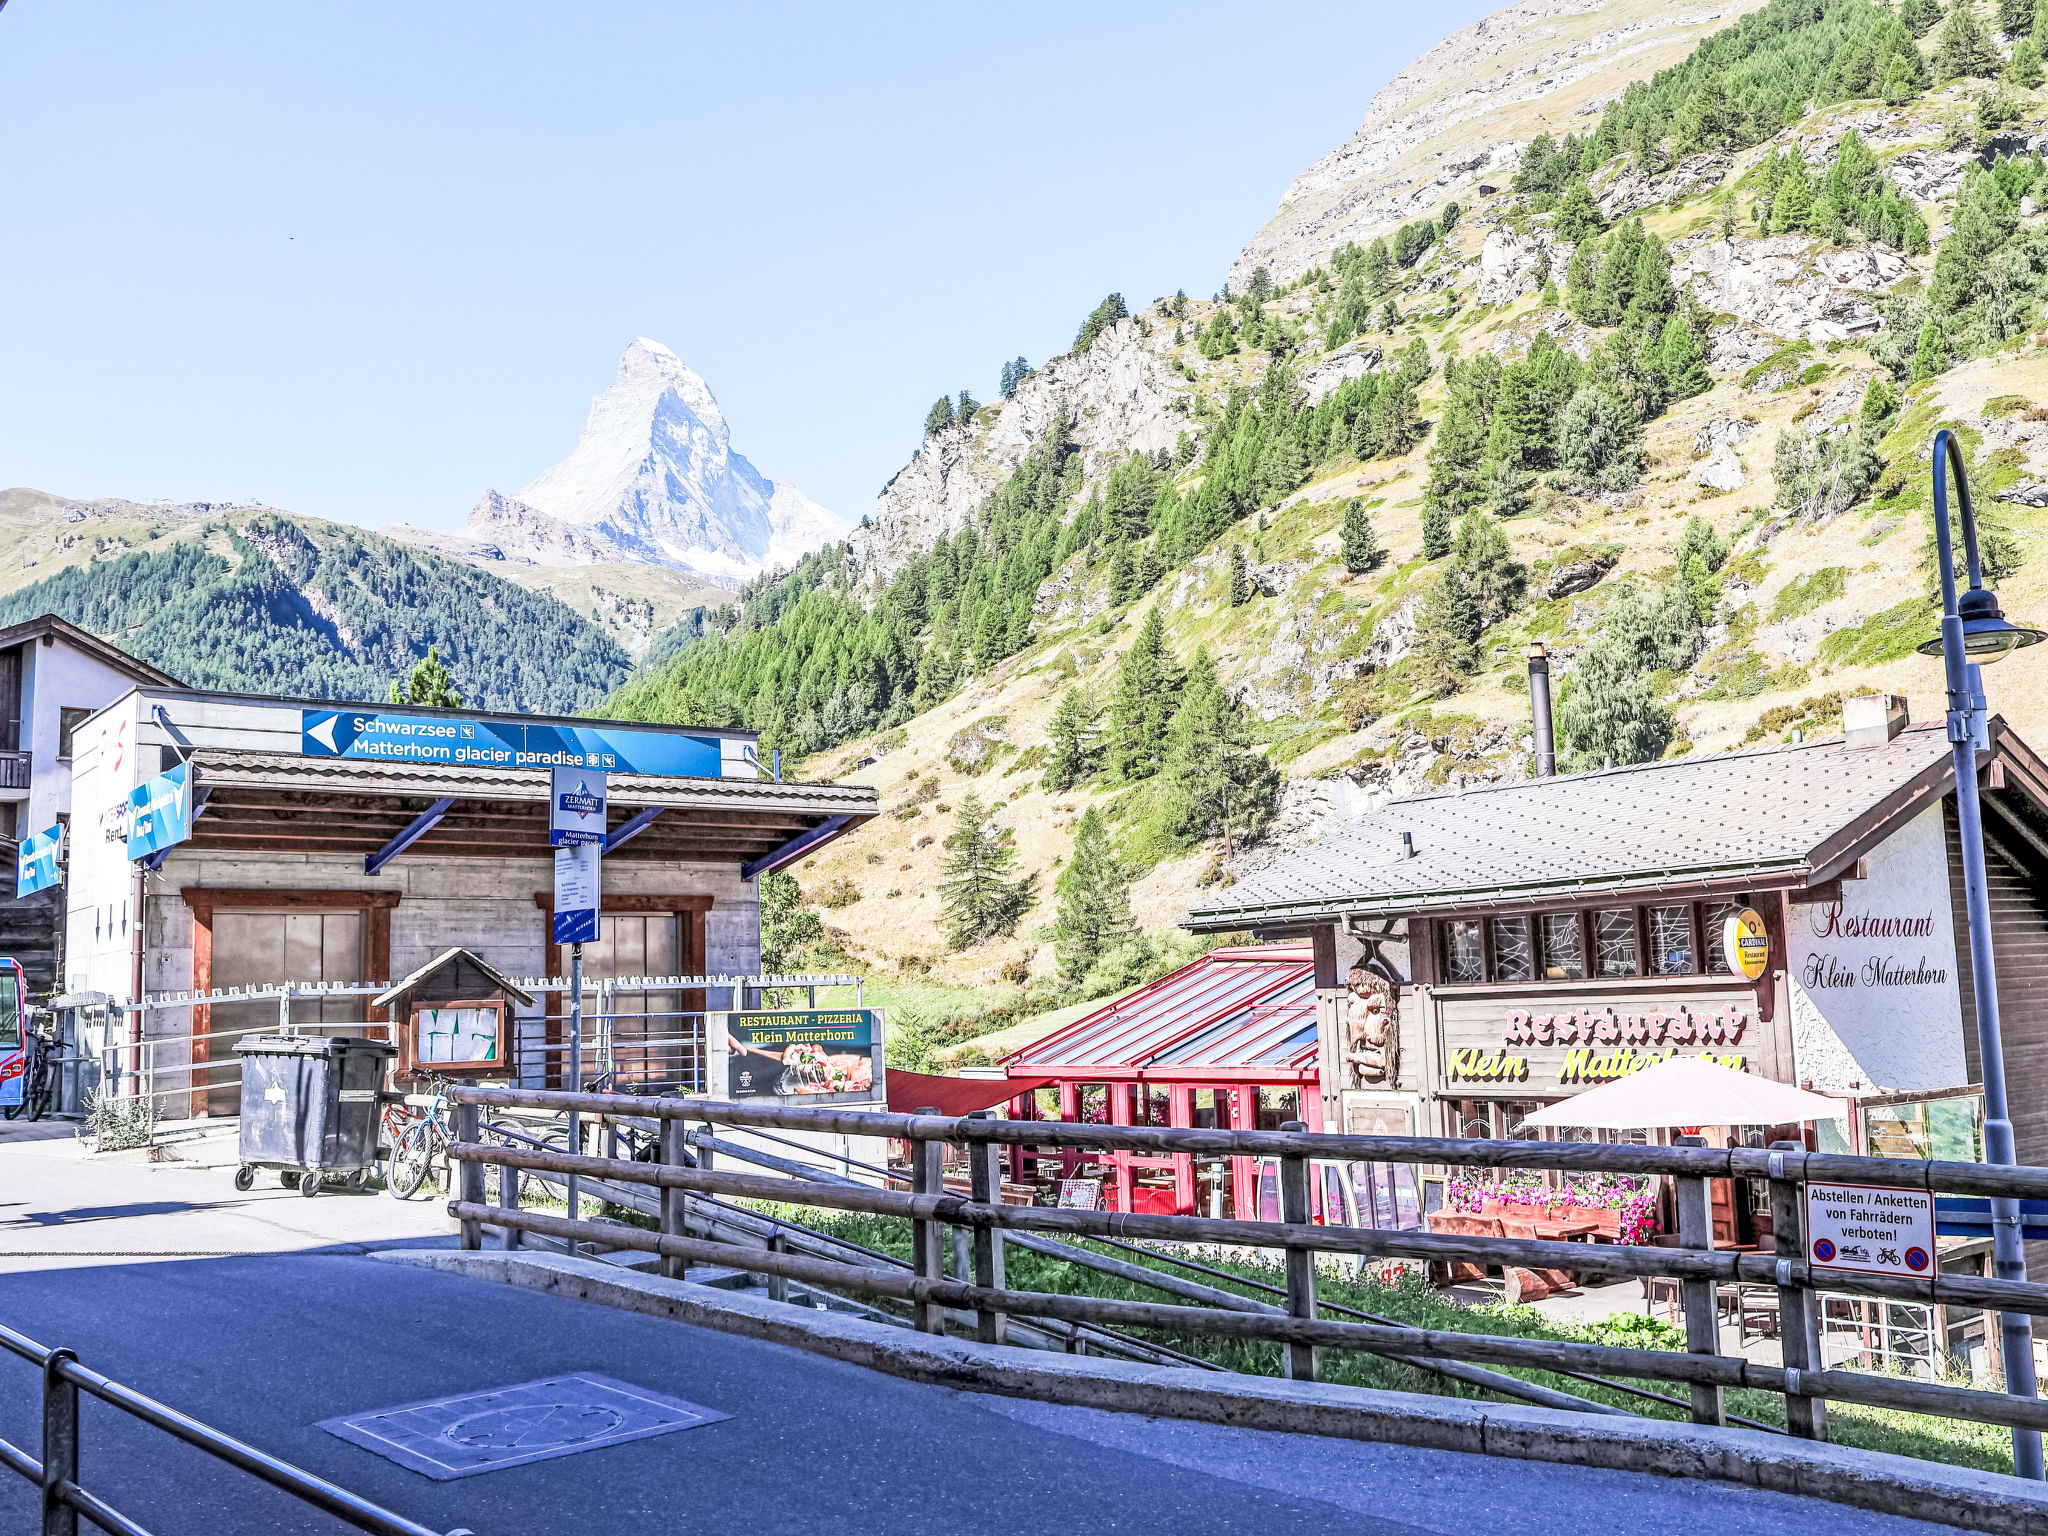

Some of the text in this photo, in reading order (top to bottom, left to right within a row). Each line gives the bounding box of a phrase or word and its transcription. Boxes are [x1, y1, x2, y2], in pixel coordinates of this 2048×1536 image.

[353, 717, 457, 738] Schwarzsee
[353, 738, 584, 766] Matterhorn glacier paradise
[565, 795, 599, 807] ZERMATT
[558, 837, 580, 847] glacier
[565, 831, 599, 841] Matterhorn
[1809, 901, 1935, 939] Restaurant
[1740, 938, 1766, 947] CARDINAL
[1803, 952, 1948, 989] Klein Matterhorn
[739, 1015, 809, 1027] RESTAURANT
[817, 1013, 863, 1025] PIZZERIA
[1502, 1003, 1746, 1043] Restaurant
[751, 1029, 855, 1044] Klein Matterhorn
[1449, 1048, 1528, 1079] Klein
[1811, 1188, 1928, 1209] Abstellen / Anketten
[1826, 1209, 1913, 1225] von Fahrrädern
[1841, 1226, 1898, 1241] verboten!
